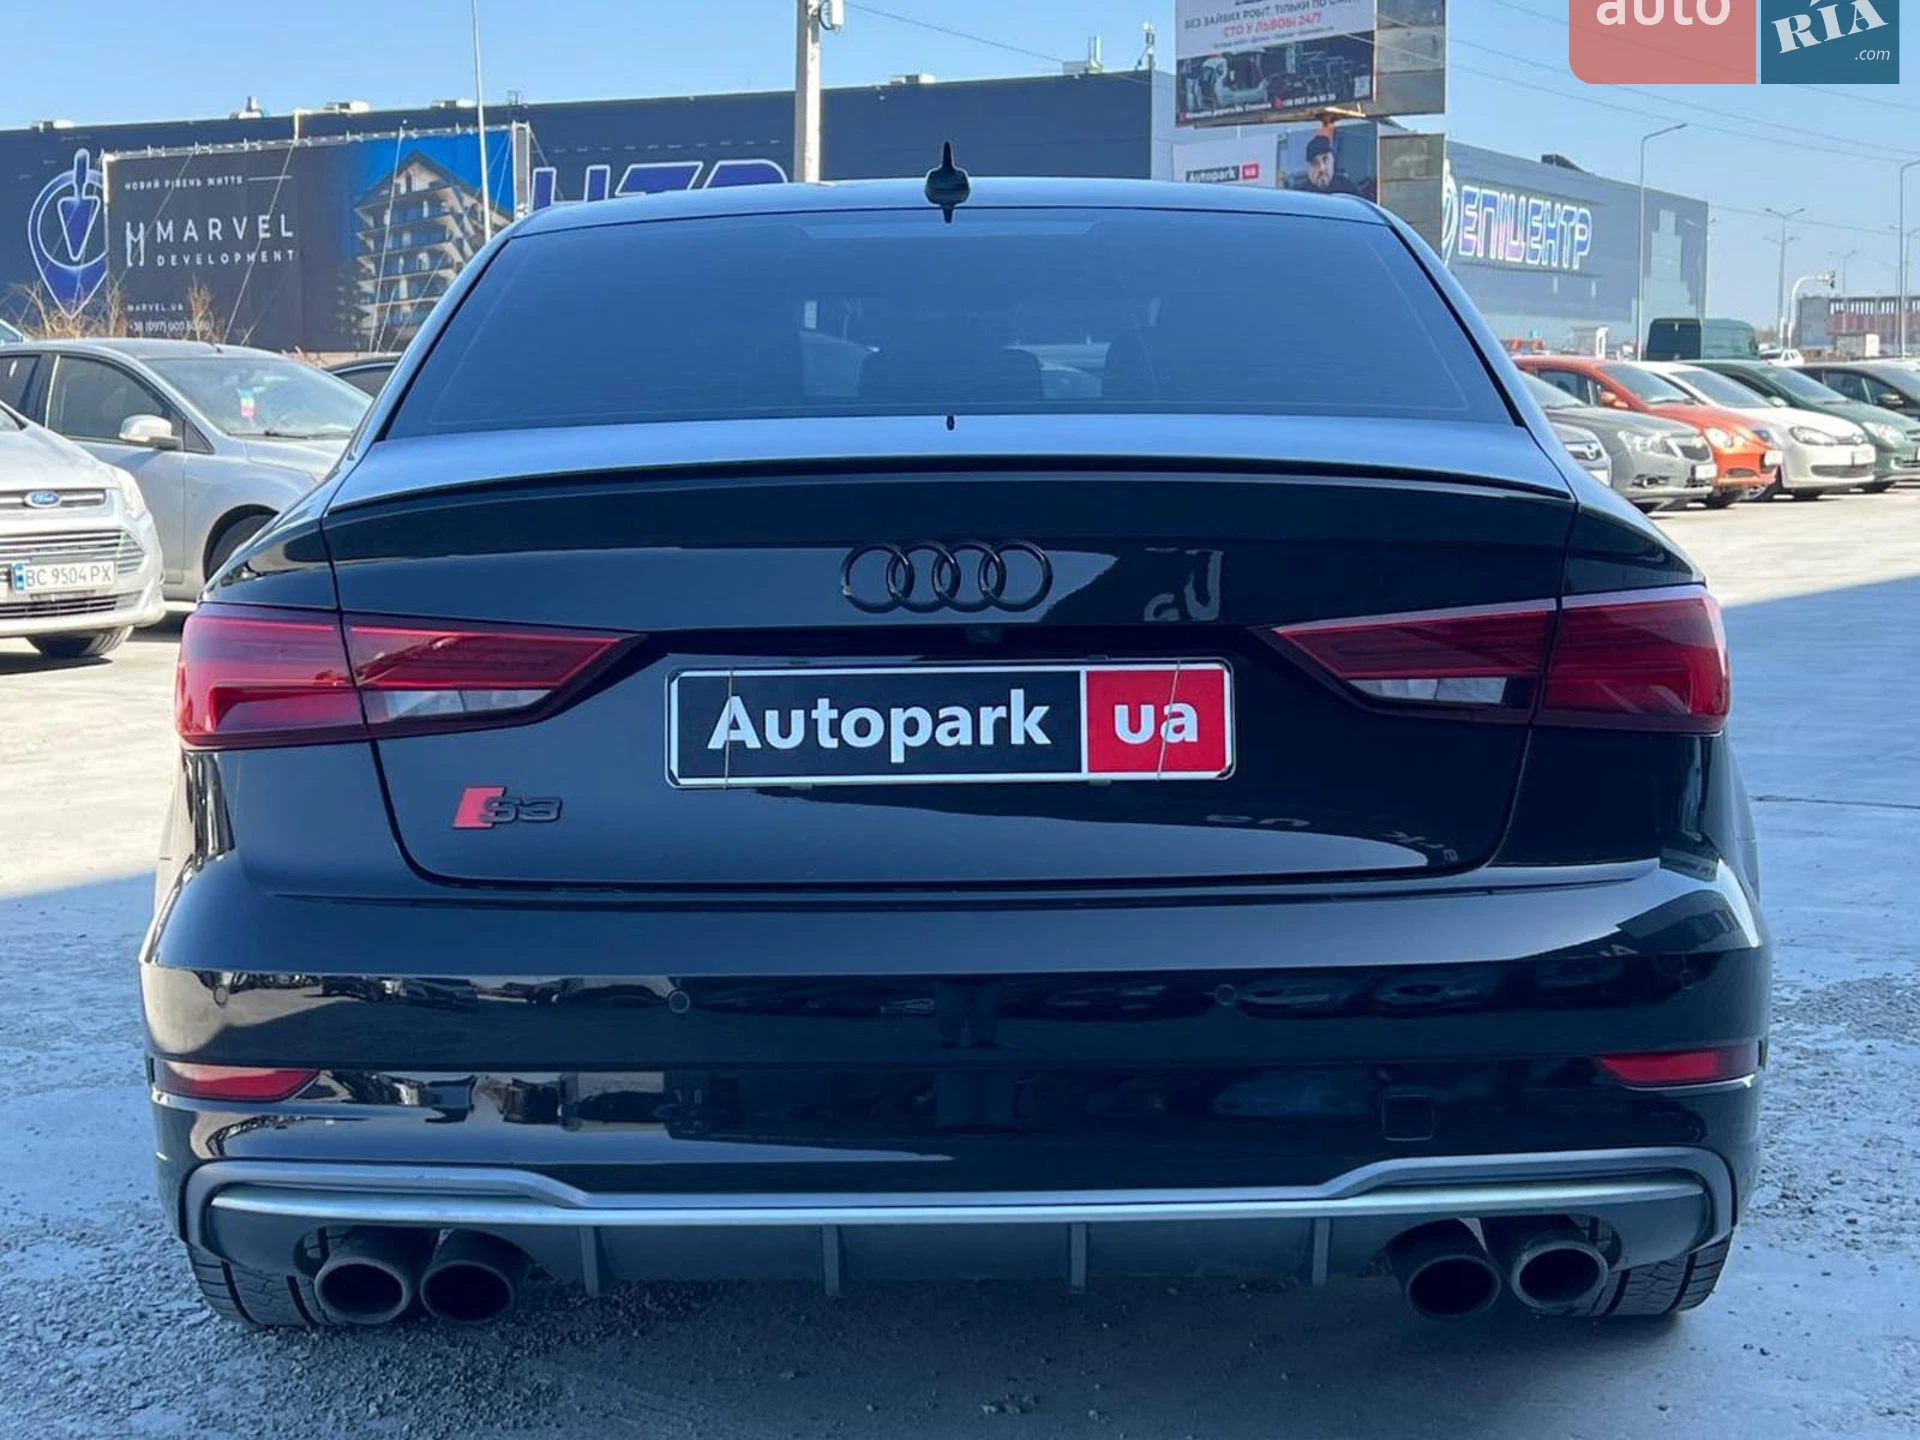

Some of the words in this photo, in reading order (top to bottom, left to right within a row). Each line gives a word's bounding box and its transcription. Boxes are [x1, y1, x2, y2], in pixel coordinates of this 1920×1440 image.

[125, 179, 160, 190] НОВИЙ
[165, 177, 201, 189] РІВЕНЬ
[207, 175, 243, 187] ЖИТТЯ
[1189, 166, 1235, 182] Autopark
[156, 213, 293, 243] MARVEL
[157, 249, 294, 266] DEVELOPMENT
[25, 567, 47, 587] BC
[52, 566, 87, 585] 9504
[90, 565, 112, 582] PX
[706, 687, 1052, 764] Autopark
[1113, 702, 1198, 743] ua
